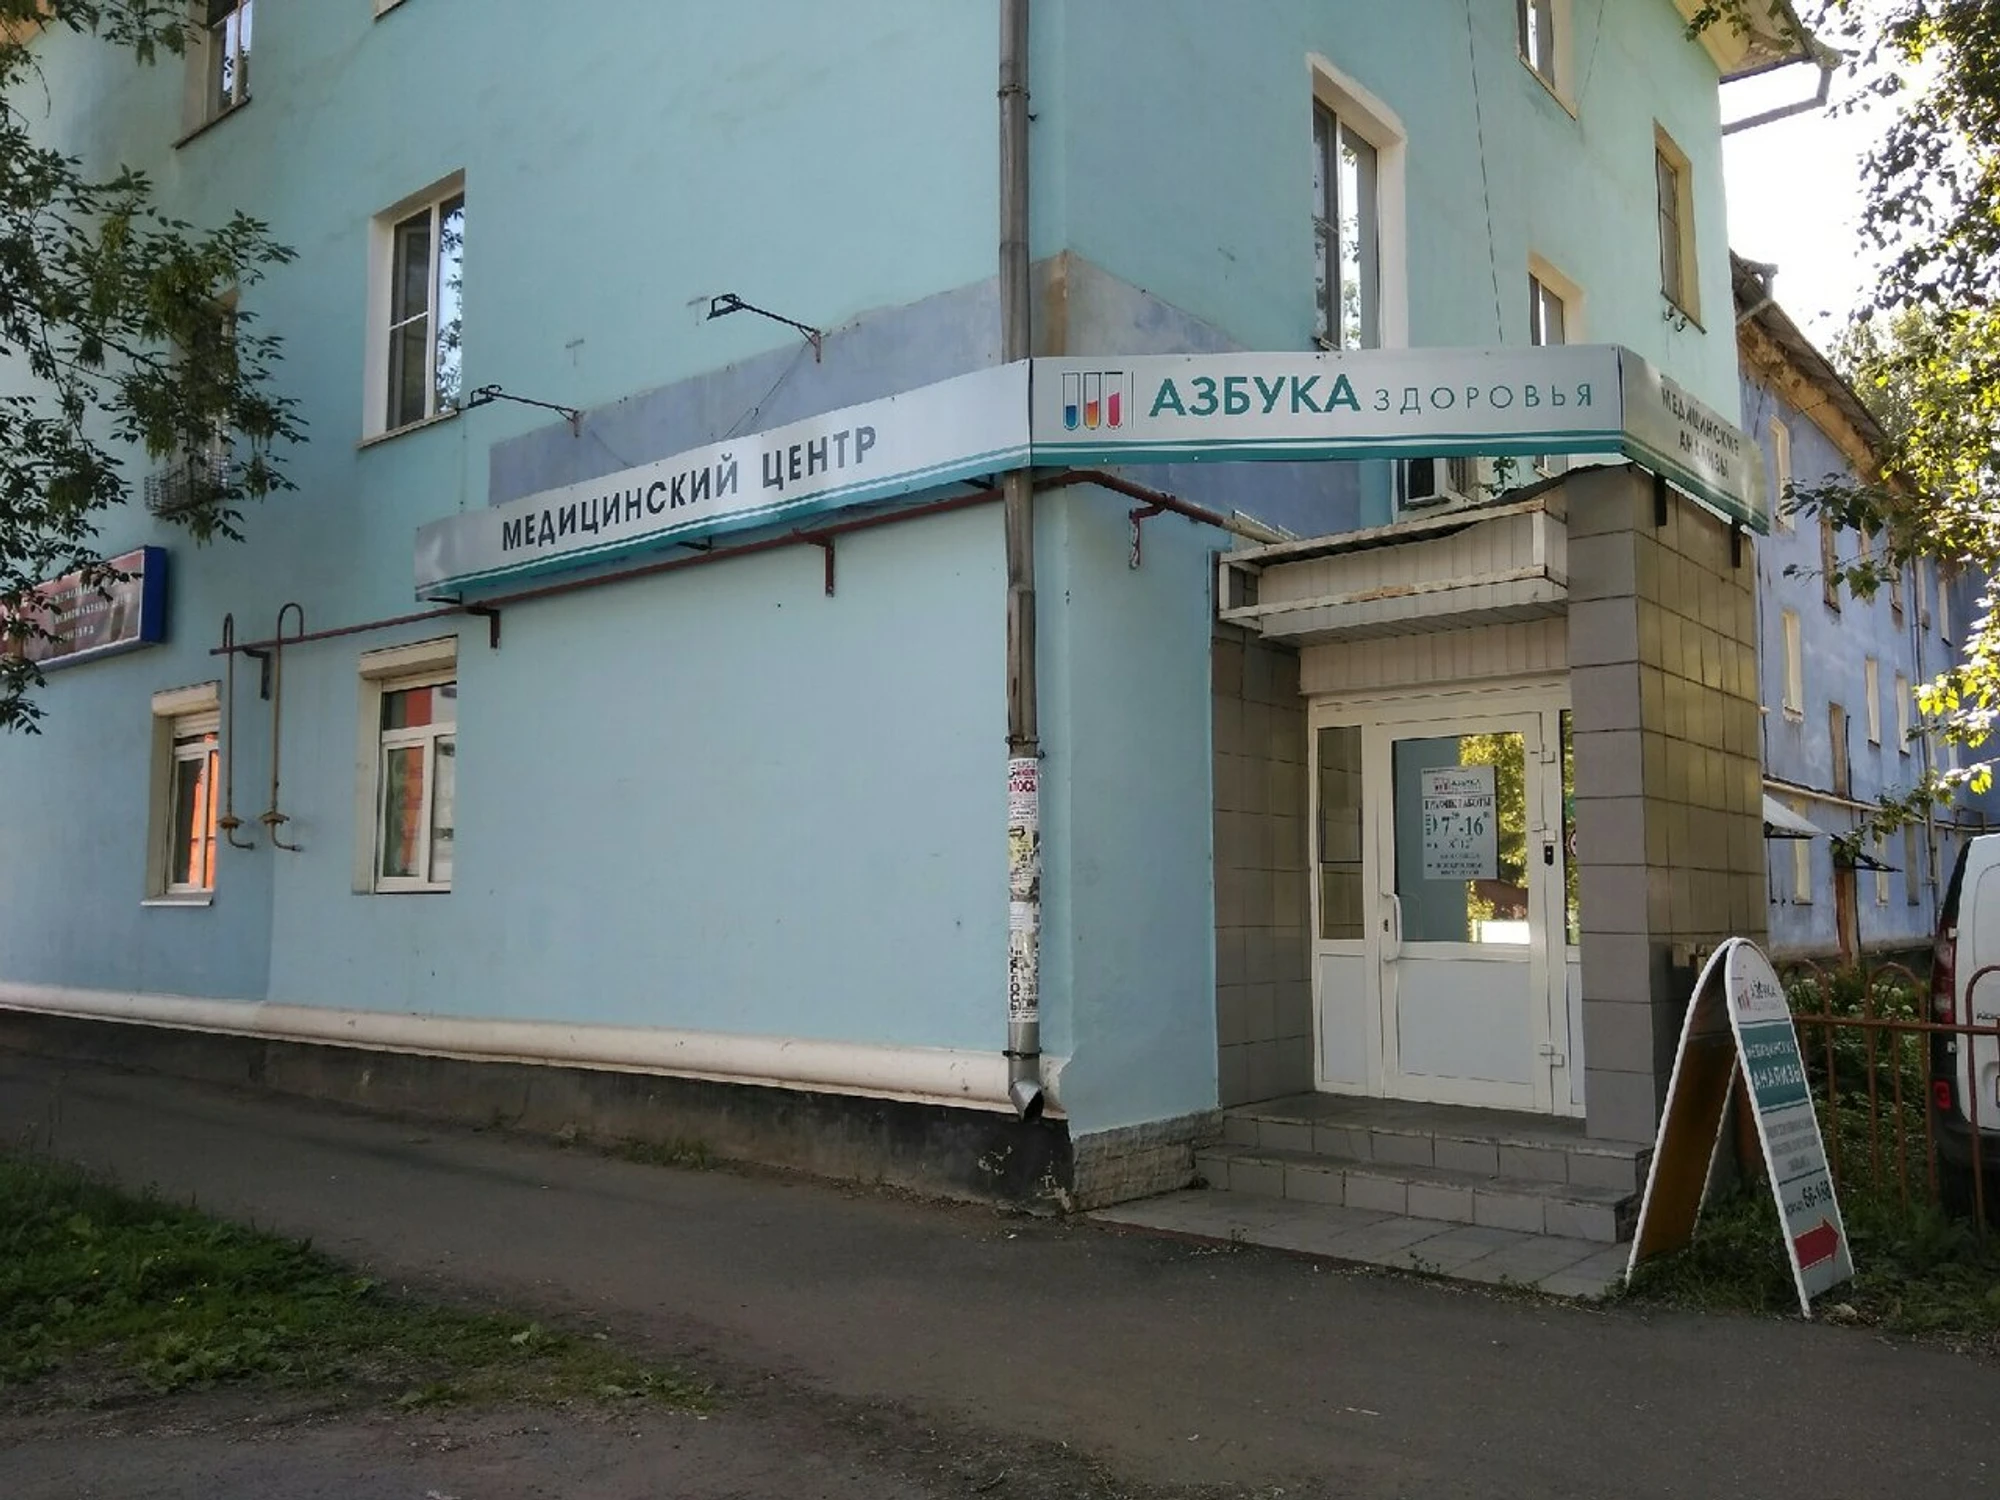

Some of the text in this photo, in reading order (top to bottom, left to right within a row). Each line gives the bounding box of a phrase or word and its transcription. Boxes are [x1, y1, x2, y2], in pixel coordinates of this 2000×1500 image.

[1149, 373, 1593, 417] АЗБУКА ЗДОРОВЬЯ
[1661, 387, 1739, 457] МЕДИЦИНСКИЕ
[502, 425, 877, 551] МЕДИЦИНСКИЙ ЦЕНТР
